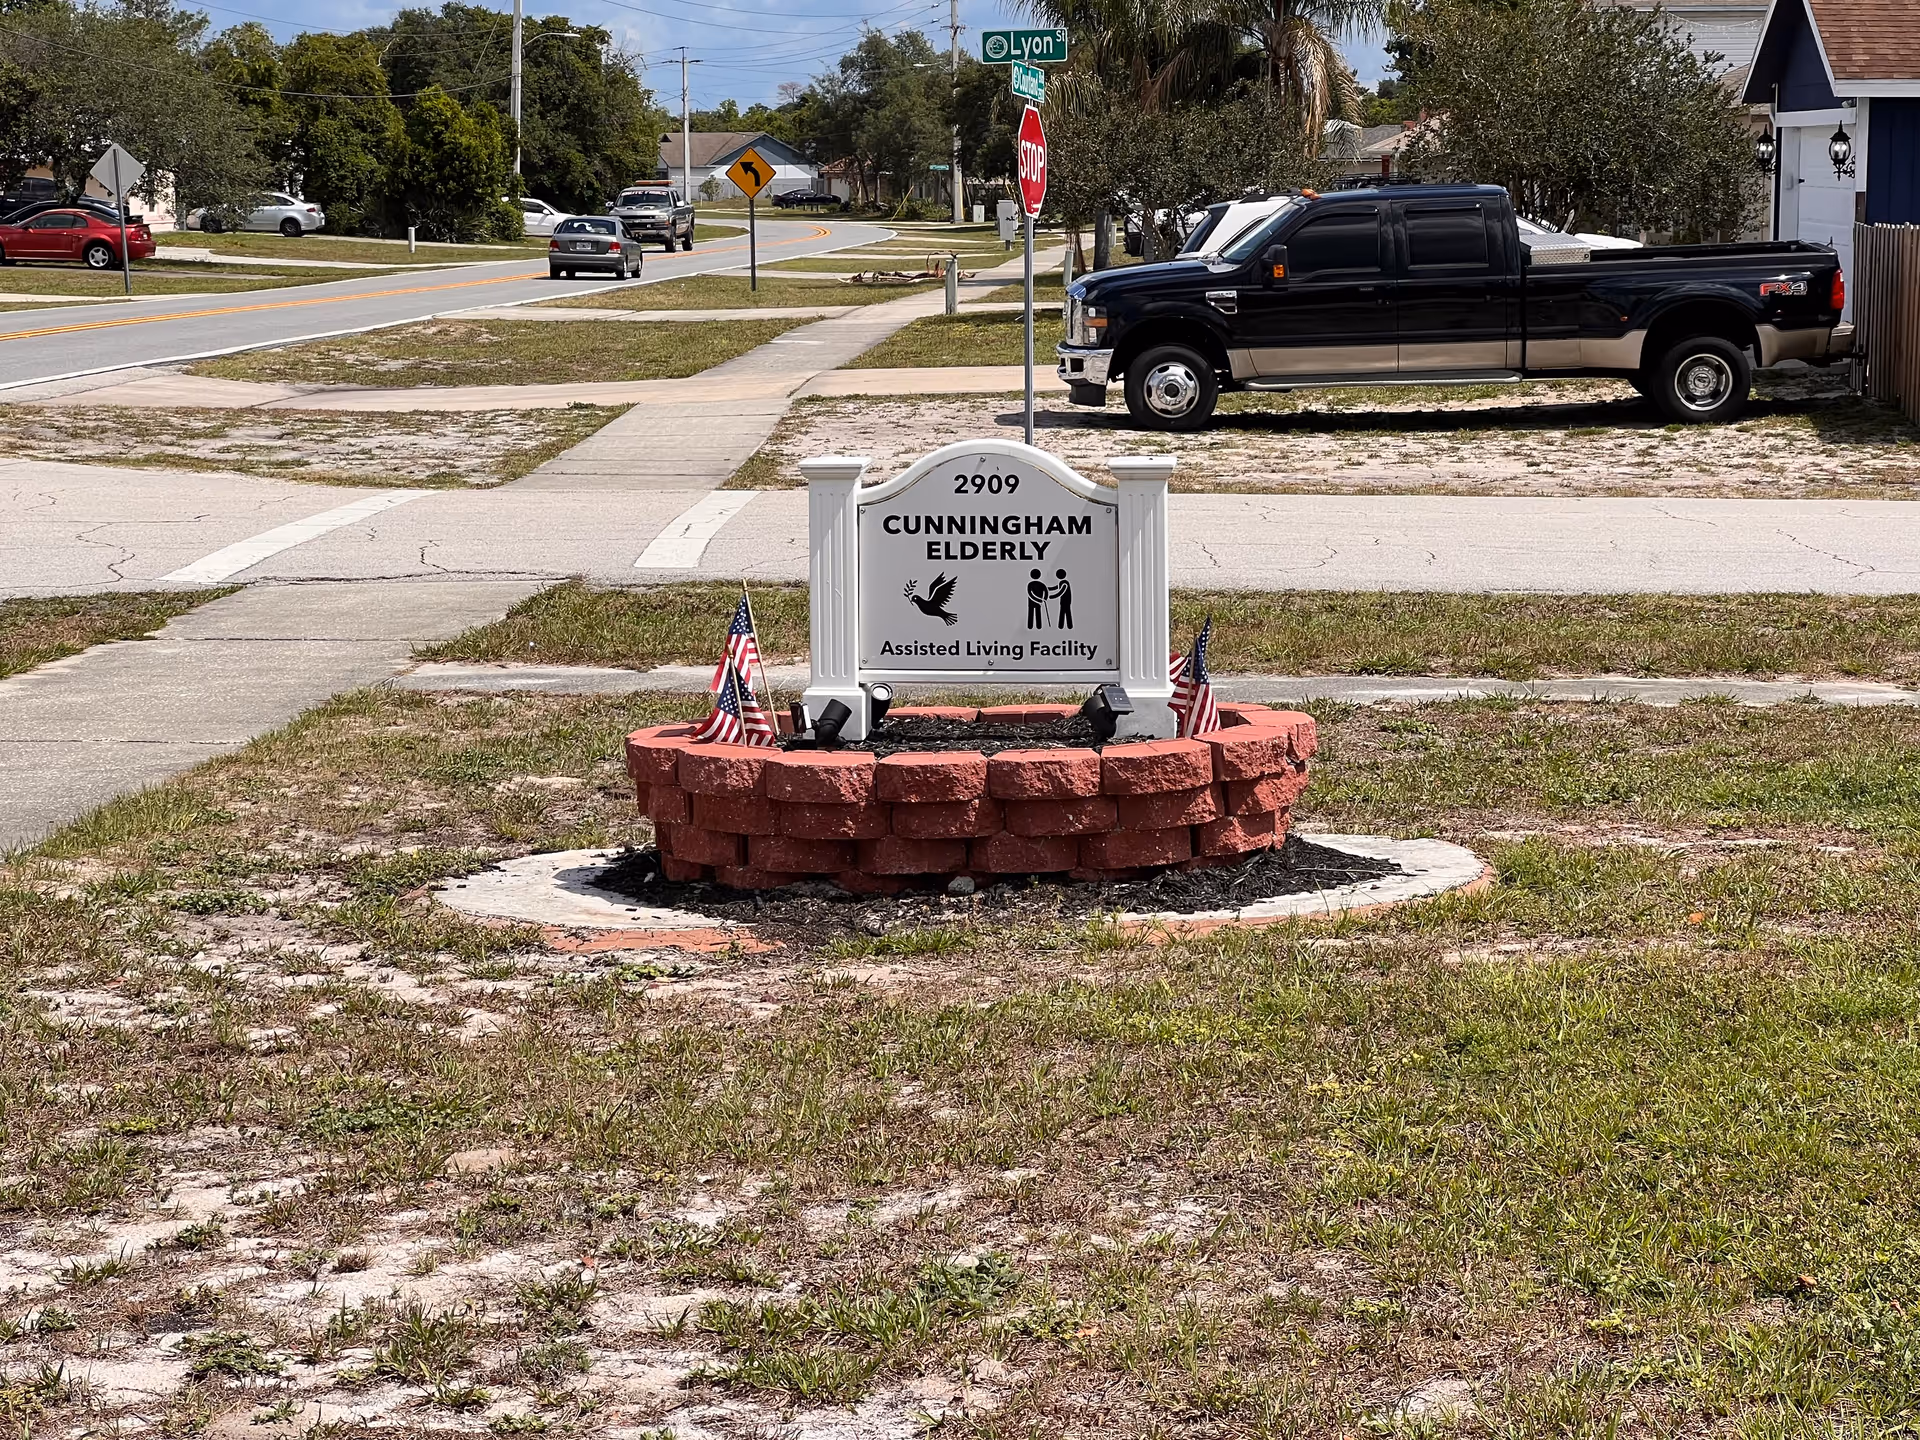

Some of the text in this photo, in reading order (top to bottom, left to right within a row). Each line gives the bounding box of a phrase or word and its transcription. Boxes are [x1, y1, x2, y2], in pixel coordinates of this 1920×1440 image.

[1011, 29, 1065, 60] Lyon St
[1020, 139, 1045, 184] STOP
[1760, 281, 1807, 296] FX4
[953, 474, 1020, 494] 2909
[882, 515, 1092, 535] CUNNINGHAM
[926, 541, 1051, 560] ELDERLY
[880, 640, 1098, 660] Assisted Living Facility
